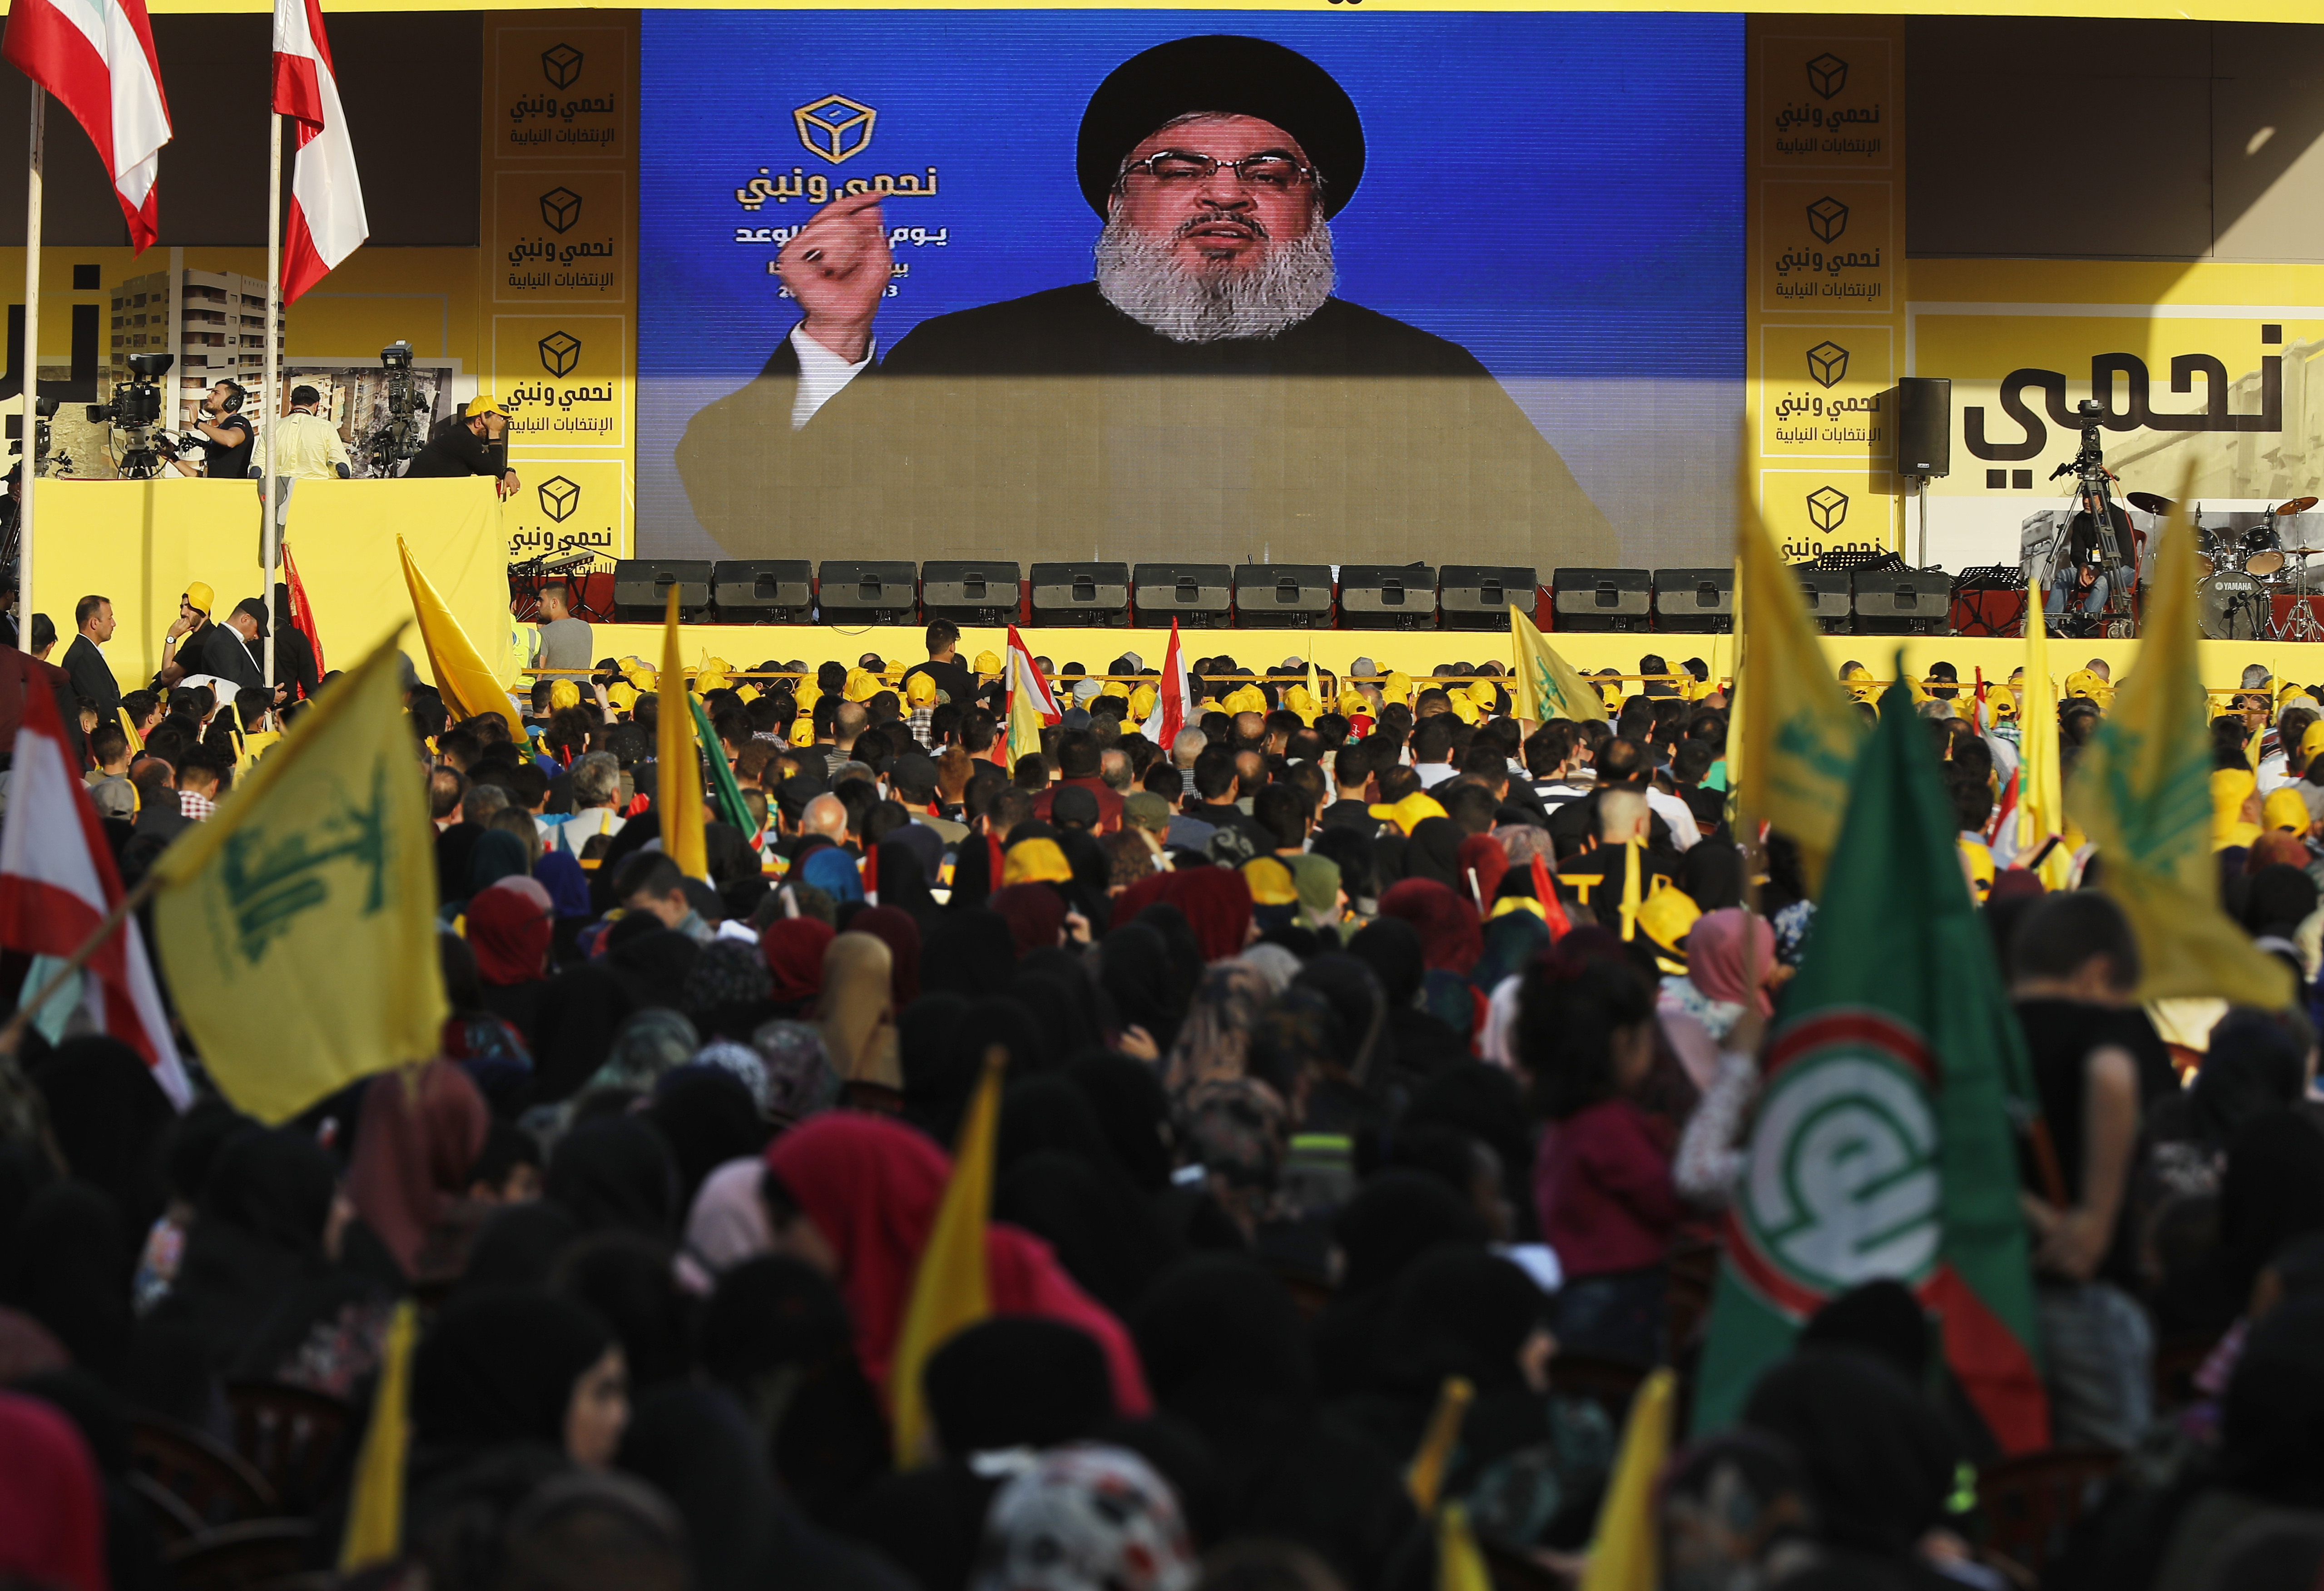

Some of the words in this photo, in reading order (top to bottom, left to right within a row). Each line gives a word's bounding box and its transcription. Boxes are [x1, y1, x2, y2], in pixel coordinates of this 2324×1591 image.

[510, 94, 557, 123] ونبني
[560, 93, 613, 123] نحمي
[1775, 102, 1822, 132] ونبني
[1826, 104, 1879, 133] نحمي
[510, 129, 551, 145] النيابية
[556, 128, 614, 147] الإنتخابات
[1776, 138, 1817, 154] النيابية
[1822, 138, 1880, 157] الإنتخابات
[736, 167, 828, 211] ونبني
[508, 237, 555, 267] ونبني
[559, 238, 613, 267] نحمي
[1775, 247, 1823, 276] ونبني
[1826, 248, 1880, 277] نحمي
[509, 272, 550, 289] النيابية
[555, 272, 613, 291] الإنتخابات
[1776, 282, 1818, 299] النيابية
[1822, 283, 1881, 302] الإنتخابات
[507, 382, 554, 411] ونبني
[559, 382, 612, 411] نحمي
[1775, 392, 1822, 421] ونبني
[1826, 392, 1880, 421] نحمي
[1964, 324, 2282, 489] نحمي
[508, 417, 549, 434] النيابية
[554, 417, 613, 436] الإنتخابات
[1776, 427, 1817, 444] النيابية
[1822, 427, 1881, 446] الإنتخابات
[508, 526, 554, 555] ونبني
[558, 527, 611, 555] نحمي
[2224, 582, 2252, 590] YAMAHA
